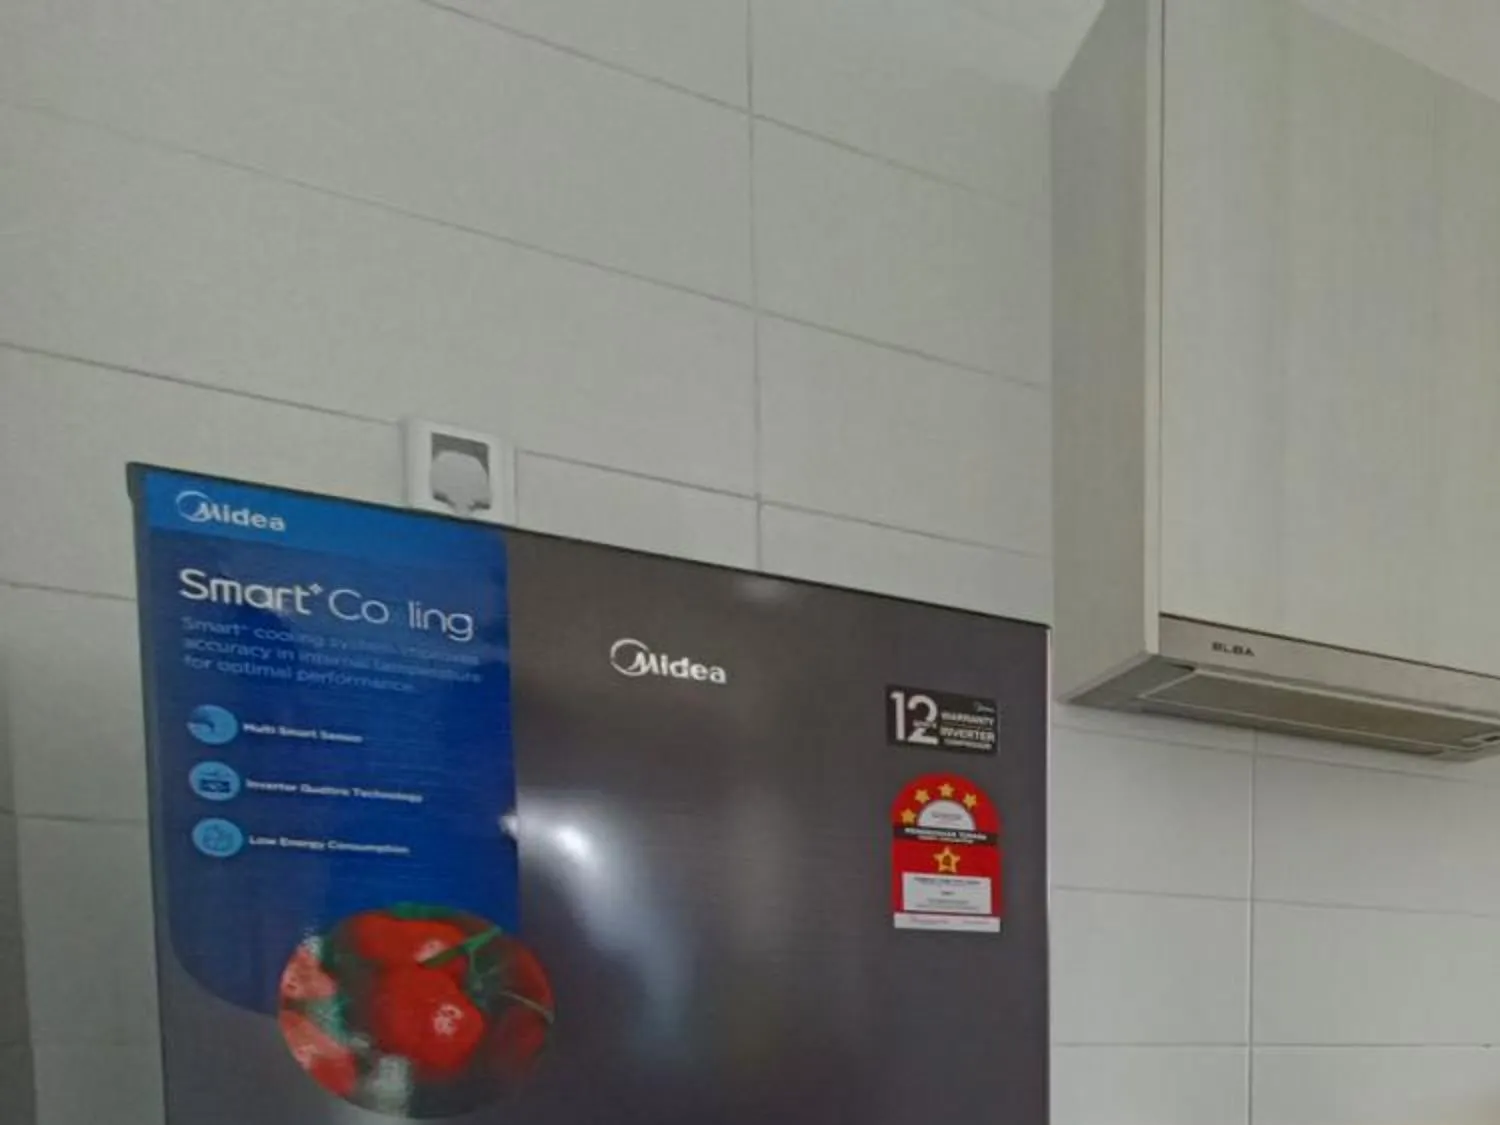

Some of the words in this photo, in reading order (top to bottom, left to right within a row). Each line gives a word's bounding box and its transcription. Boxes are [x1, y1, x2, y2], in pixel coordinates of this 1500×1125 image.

[176, 490, 286, 531] Midea
[609, 638, 727, 684] Midea
[890, 691, 939, 745] 12
